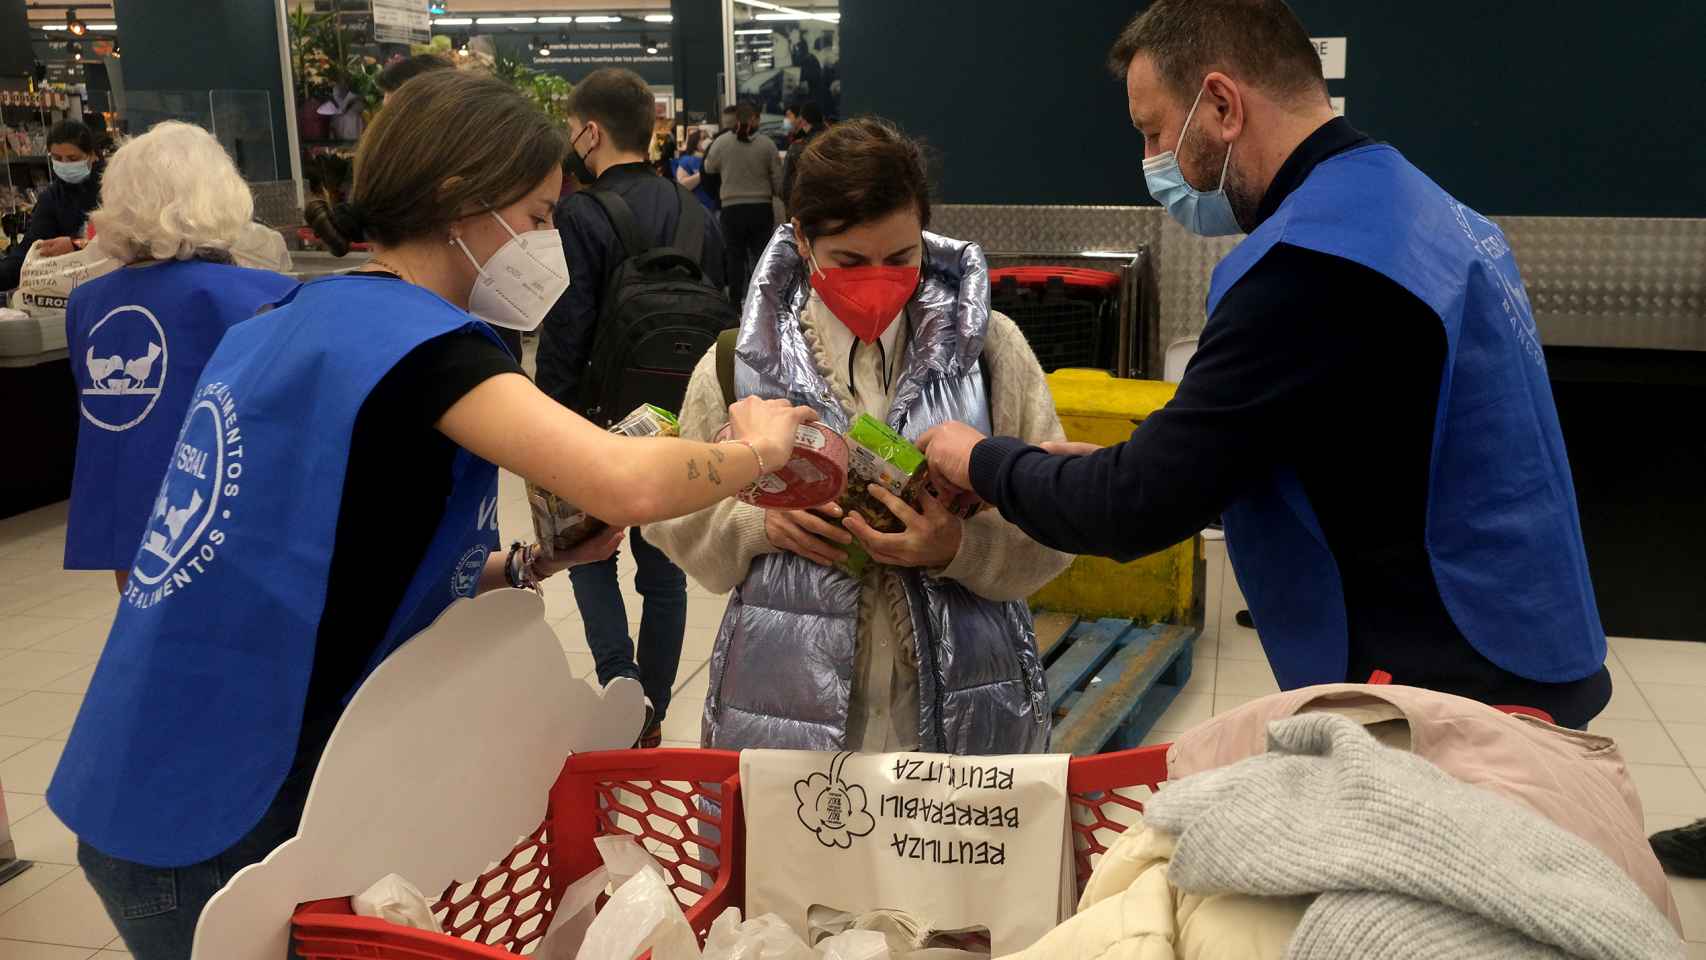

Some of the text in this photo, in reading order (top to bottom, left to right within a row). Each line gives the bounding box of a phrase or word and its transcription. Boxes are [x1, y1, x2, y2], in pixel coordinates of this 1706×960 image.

[892, 759, 1014, 790] REUTILITZA
[879, 794, 1020, 829] BERRERABILI
[890, 832, 1006, 865] REUTILIZA
